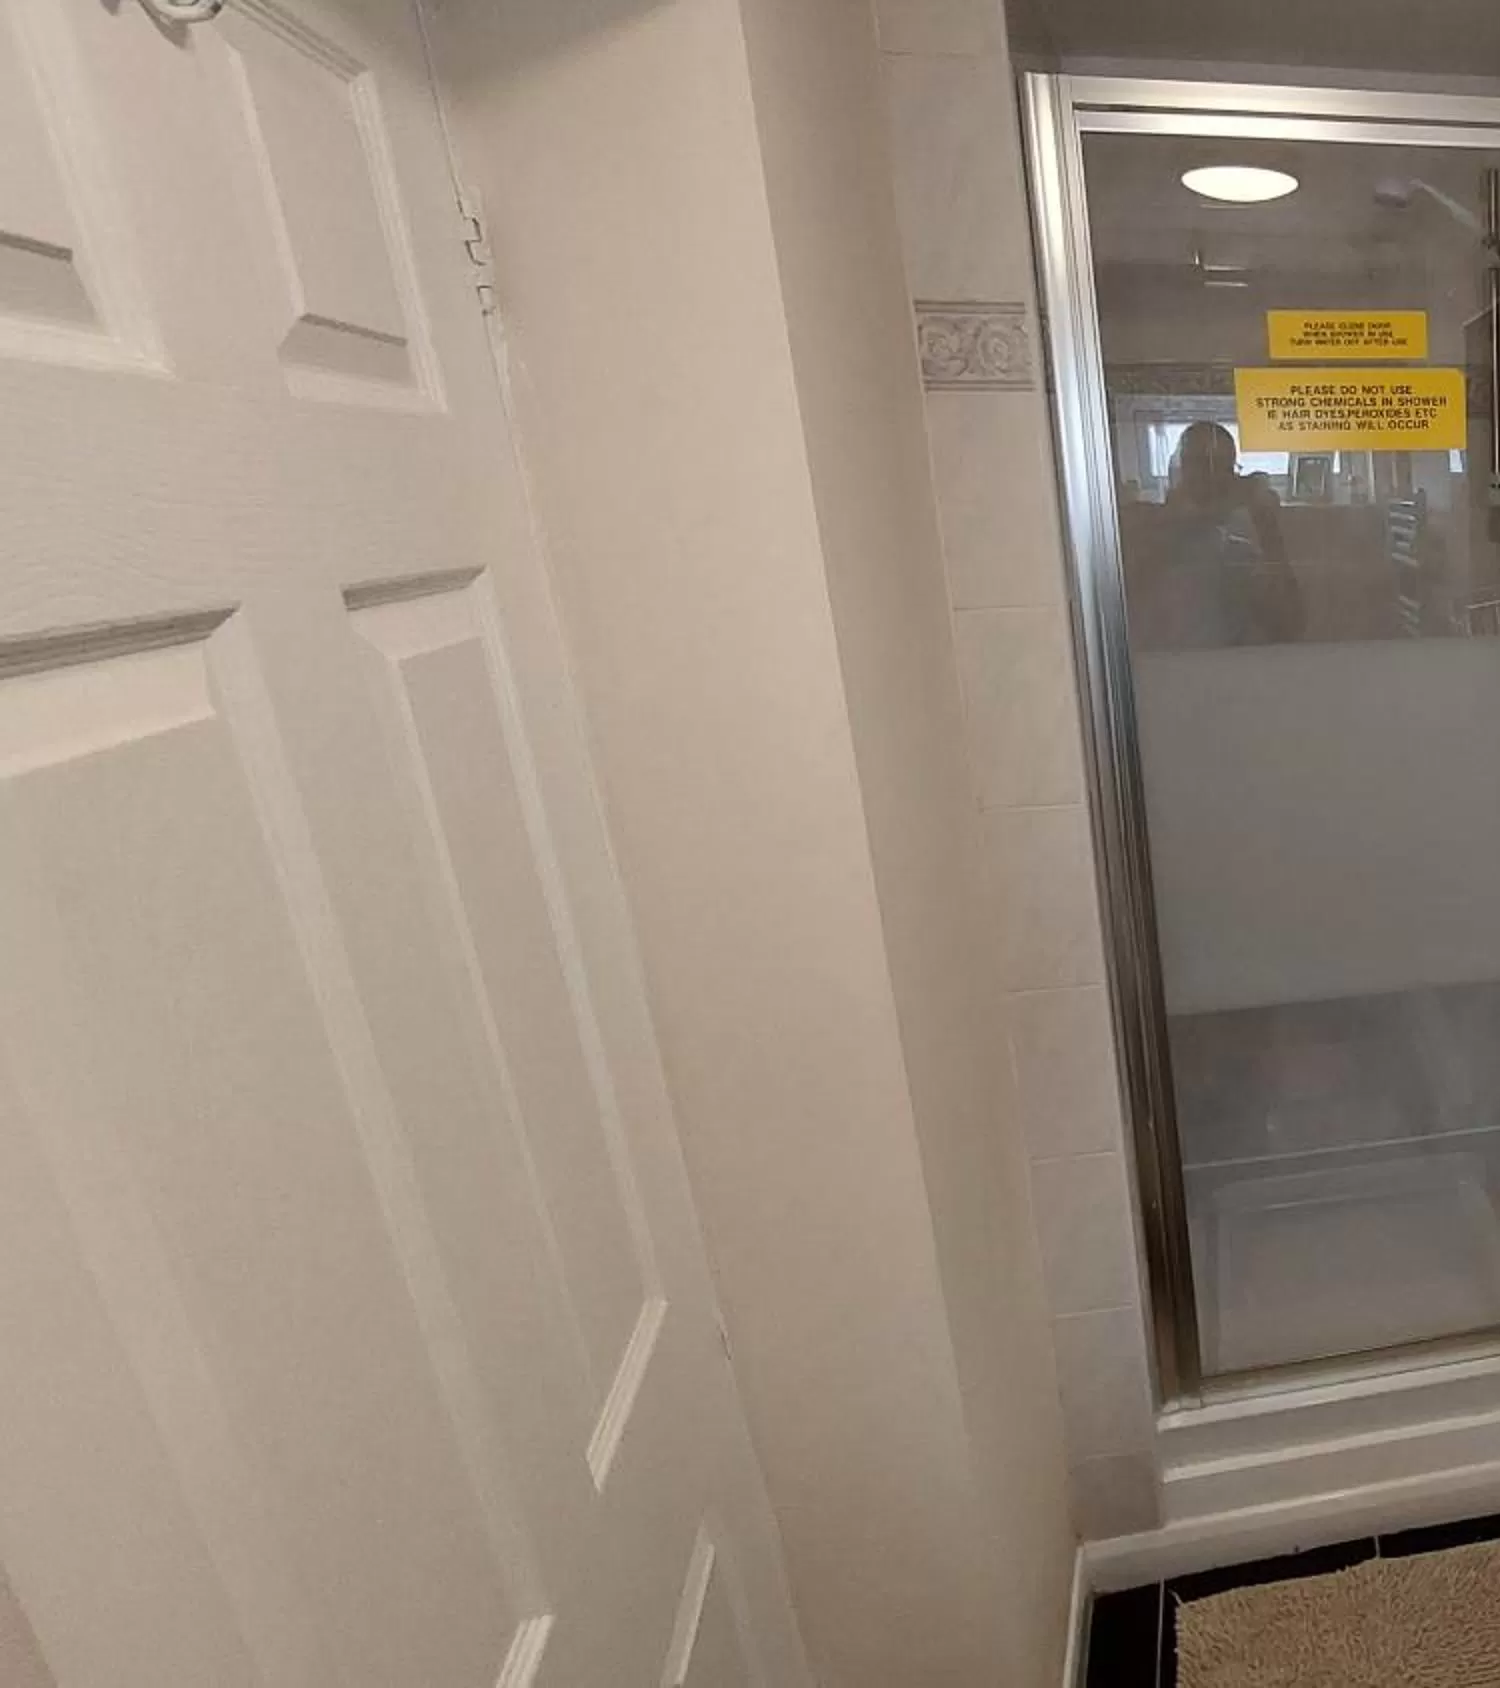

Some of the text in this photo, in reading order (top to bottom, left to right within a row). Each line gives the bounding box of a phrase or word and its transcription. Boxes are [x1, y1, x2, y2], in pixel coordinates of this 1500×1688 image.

[1290, 385, 1413, 395] PLEASE DO NOT USE
[1256, 396, 1447, 408] STRONG CHEMICALS IN SHOWER
[1283, 410, 1311, 419] HAIR
[1415, 408, 1438, 418] ETC
[1279, 420, 1430, 431] AS STAINING WILL OCCUR
